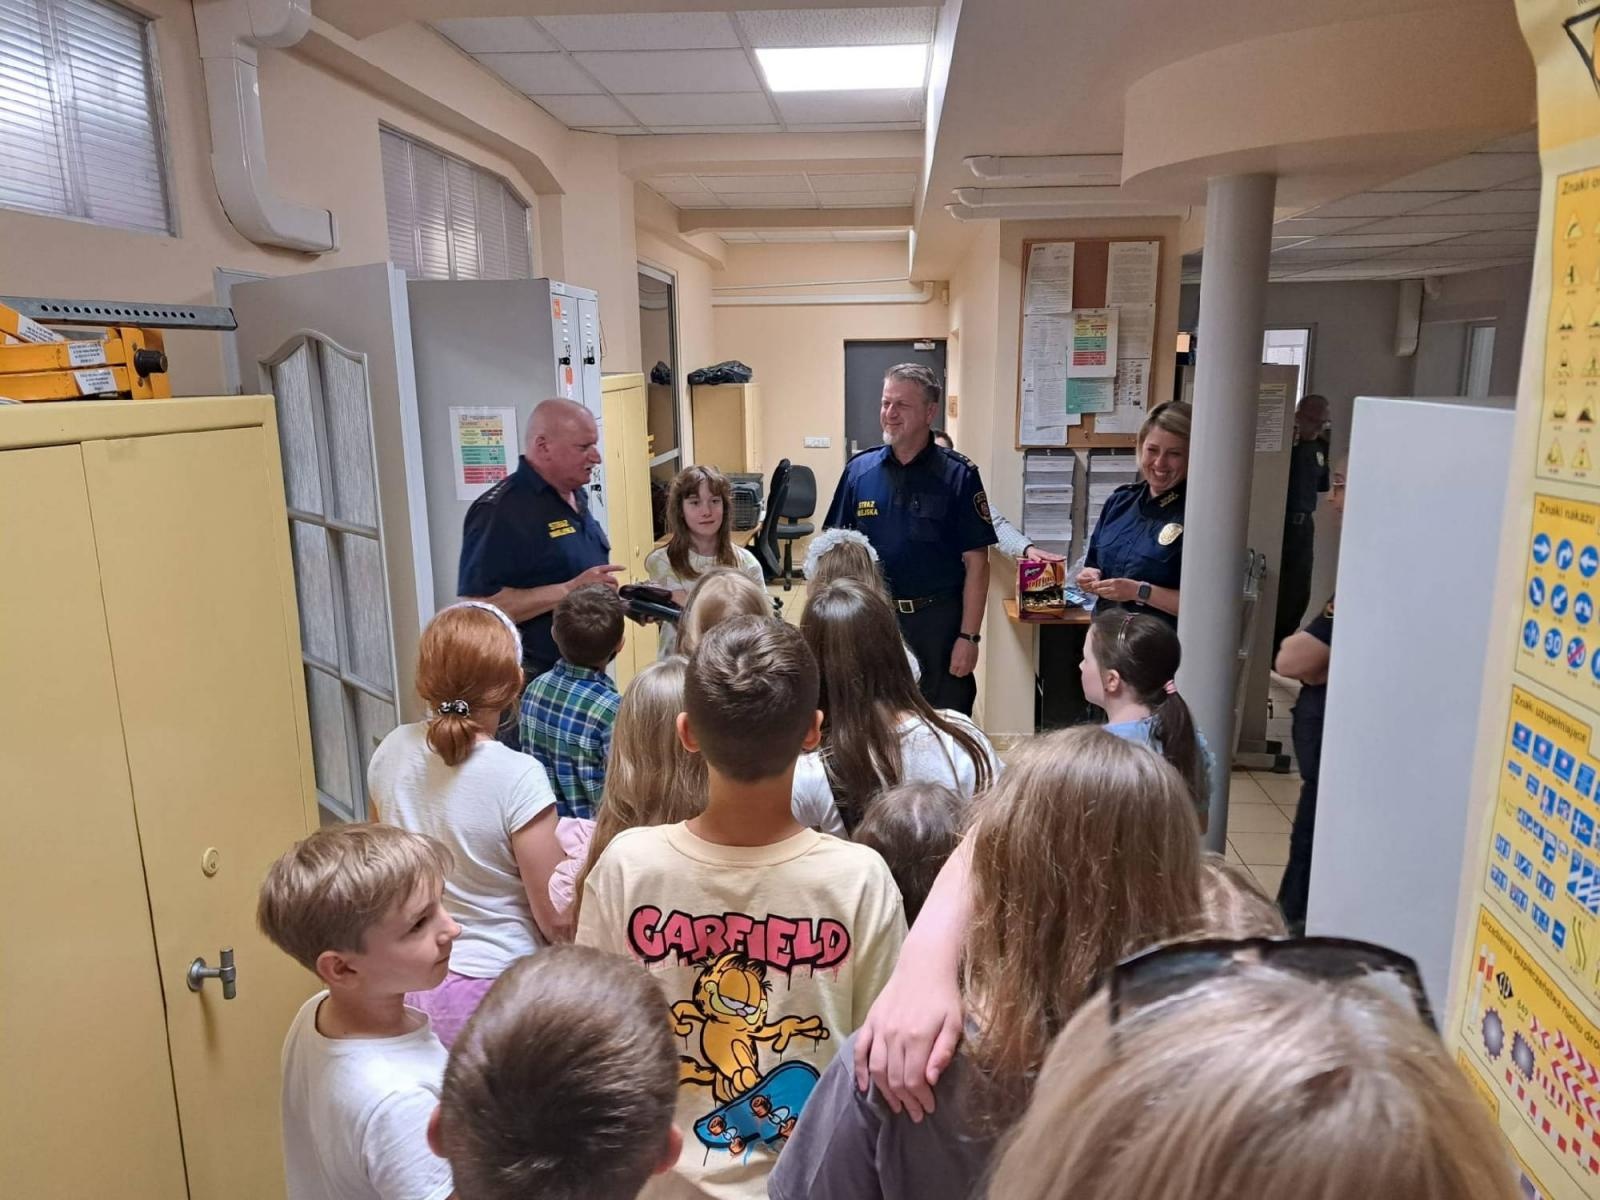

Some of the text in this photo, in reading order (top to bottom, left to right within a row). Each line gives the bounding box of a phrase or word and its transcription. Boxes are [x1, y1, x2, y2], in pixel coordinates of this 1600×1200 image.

[1540, 501, 1563, 517] Znaki
[628, 904, 851, 974] GARFIELD
[1583, 1030, 1600, 1051] dro
